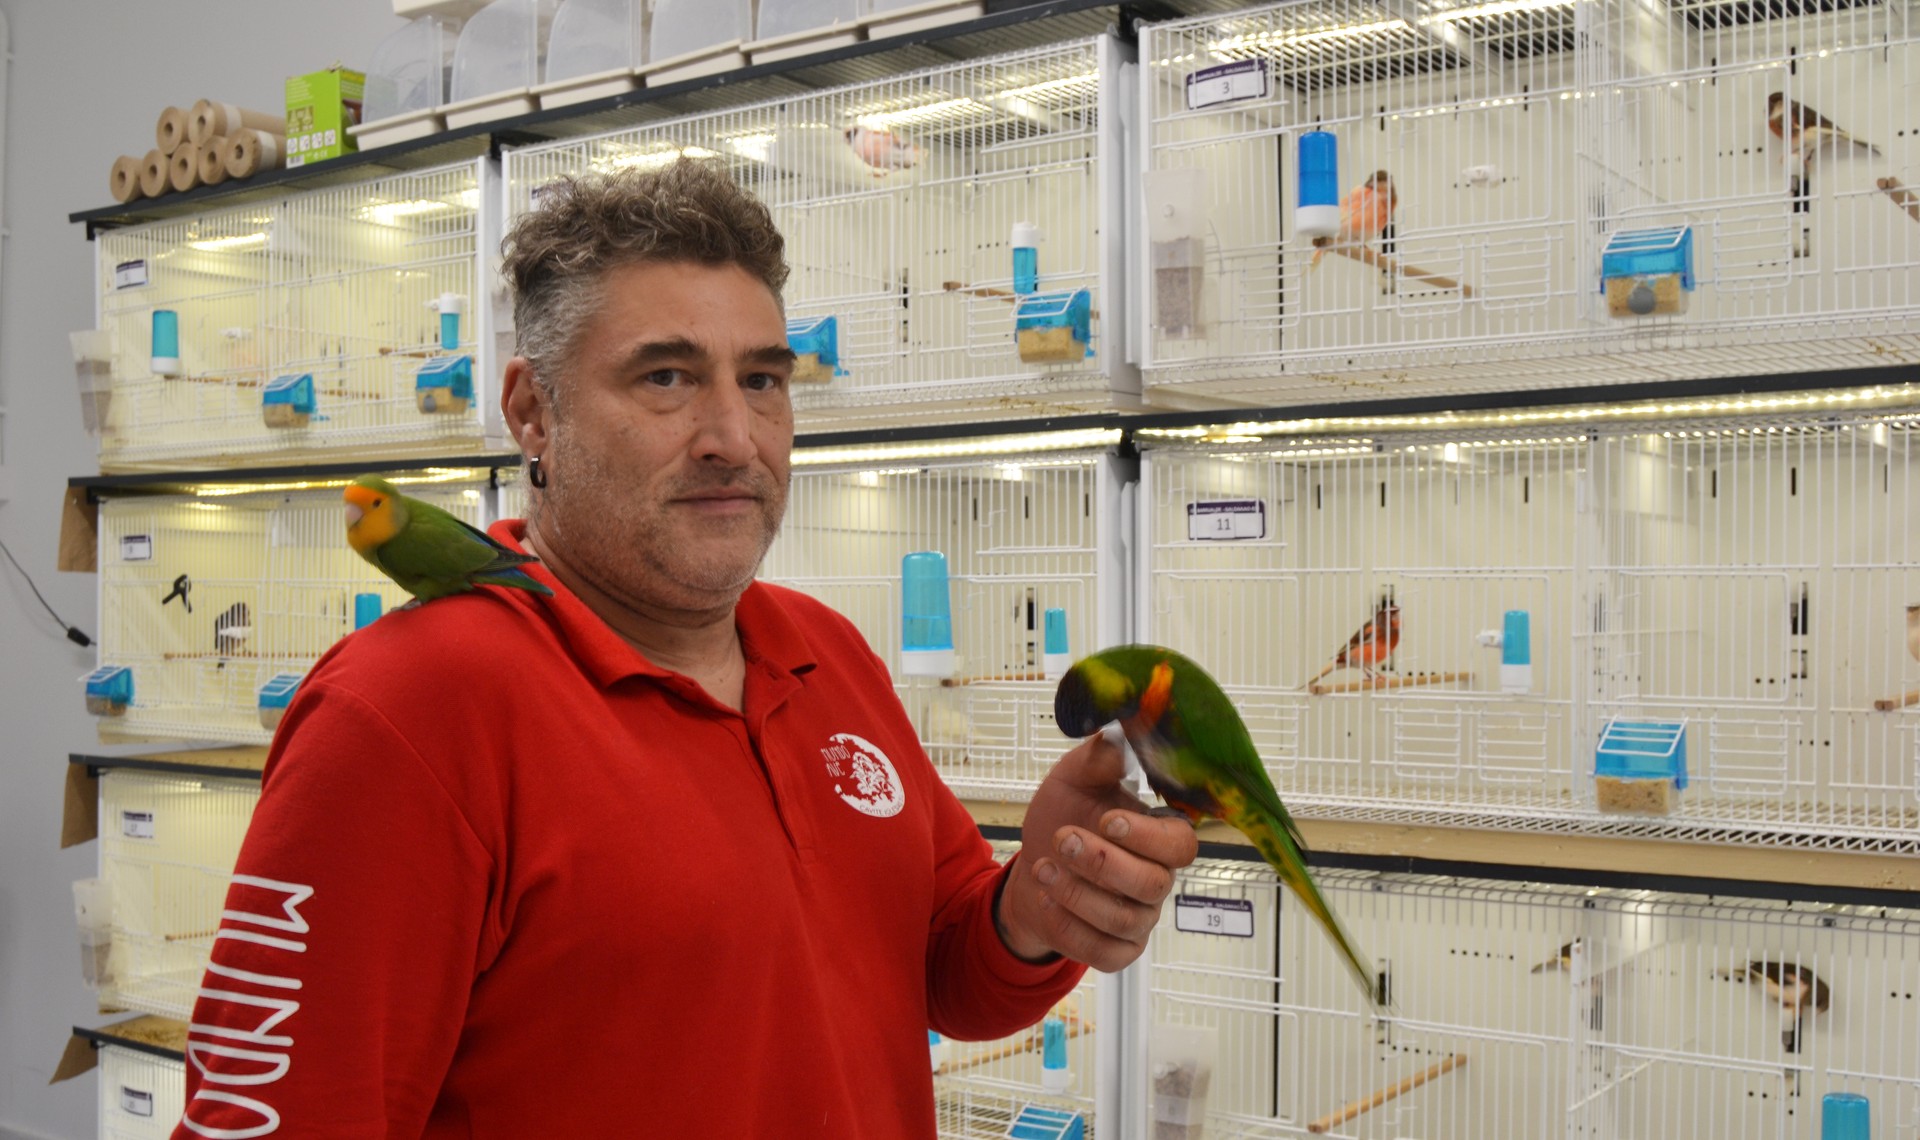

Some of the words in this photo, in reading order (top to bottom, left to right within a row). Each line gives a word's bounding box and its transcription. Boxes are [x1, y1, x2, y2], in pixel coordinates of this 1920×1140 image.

[1222, 81, 1230, 94] 3
[1217, 518, 1231, 531] 11
[820, 745, 851, 763] MUNDO
[1207, 913, 1221, 927] 19
[183, 874, 314, 1140] MUNDO
